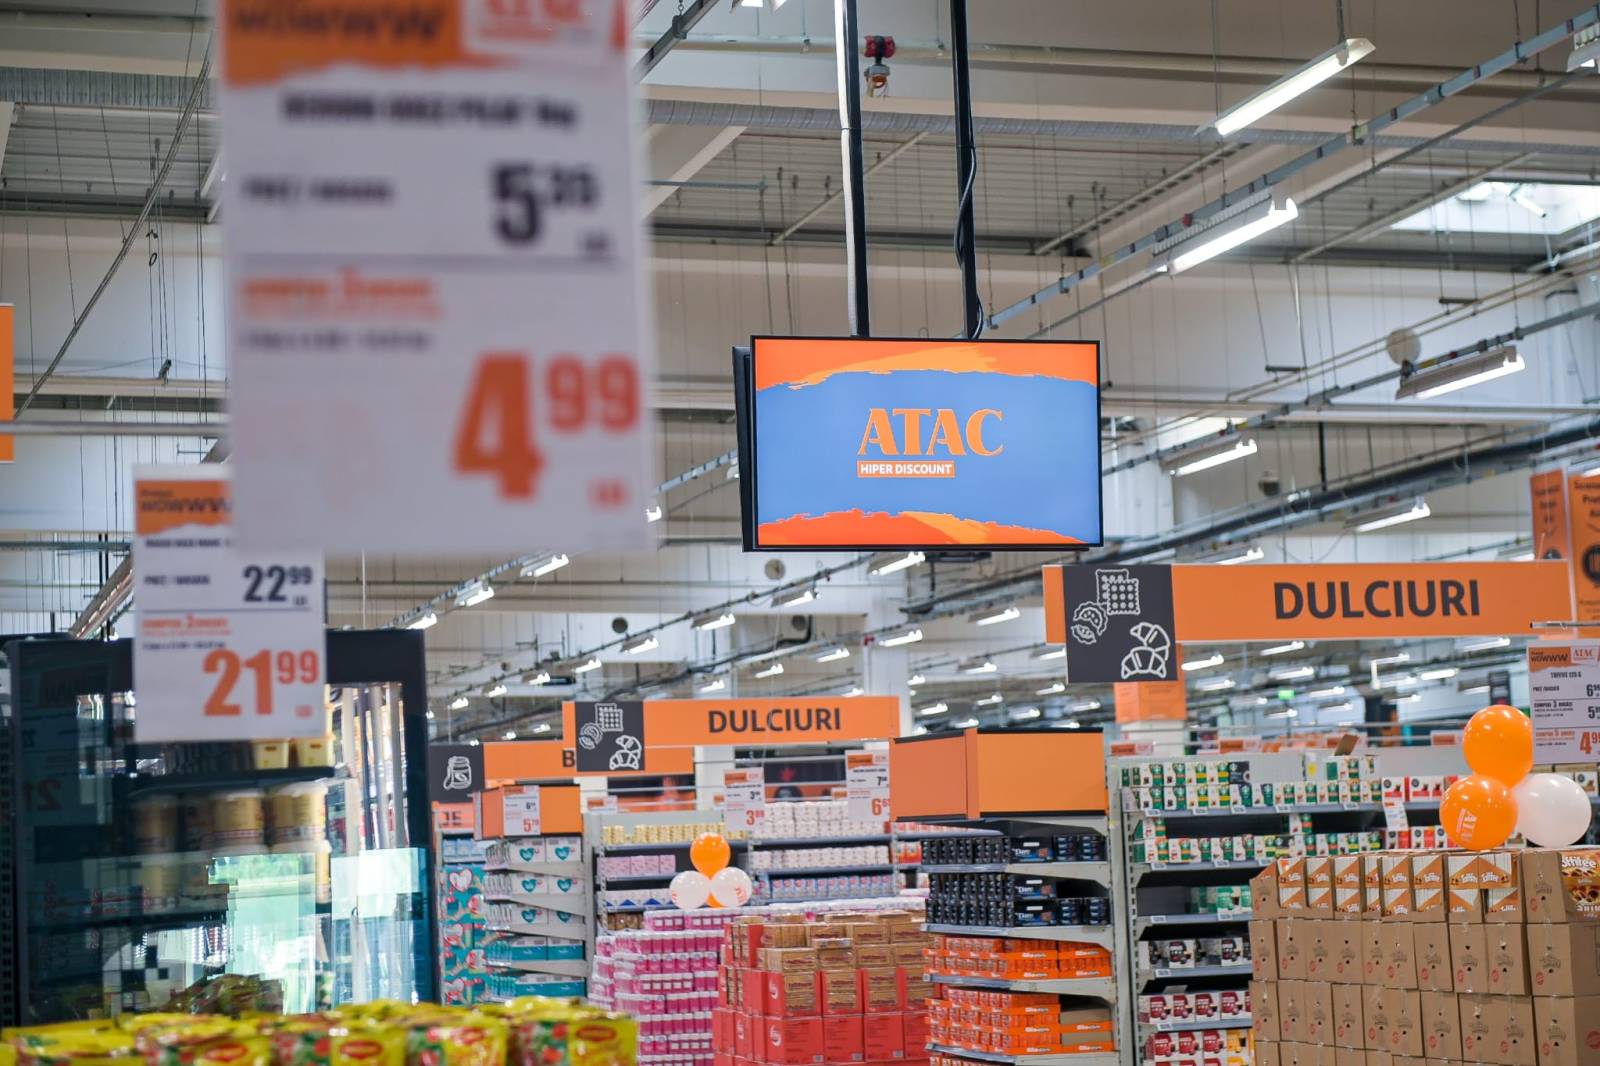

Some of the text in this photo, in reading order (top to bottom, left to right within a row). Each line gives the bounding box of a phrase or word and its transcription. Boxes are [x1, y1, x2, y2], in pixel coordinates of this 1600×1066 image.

[857, 408, 1004, 457] ATAC
[860, 463, 953, 475] HIPER DISCOUNT
[1274, 579, 1481, 619] DULCIURI
[708, 708, 841, 733] DULCIURI
